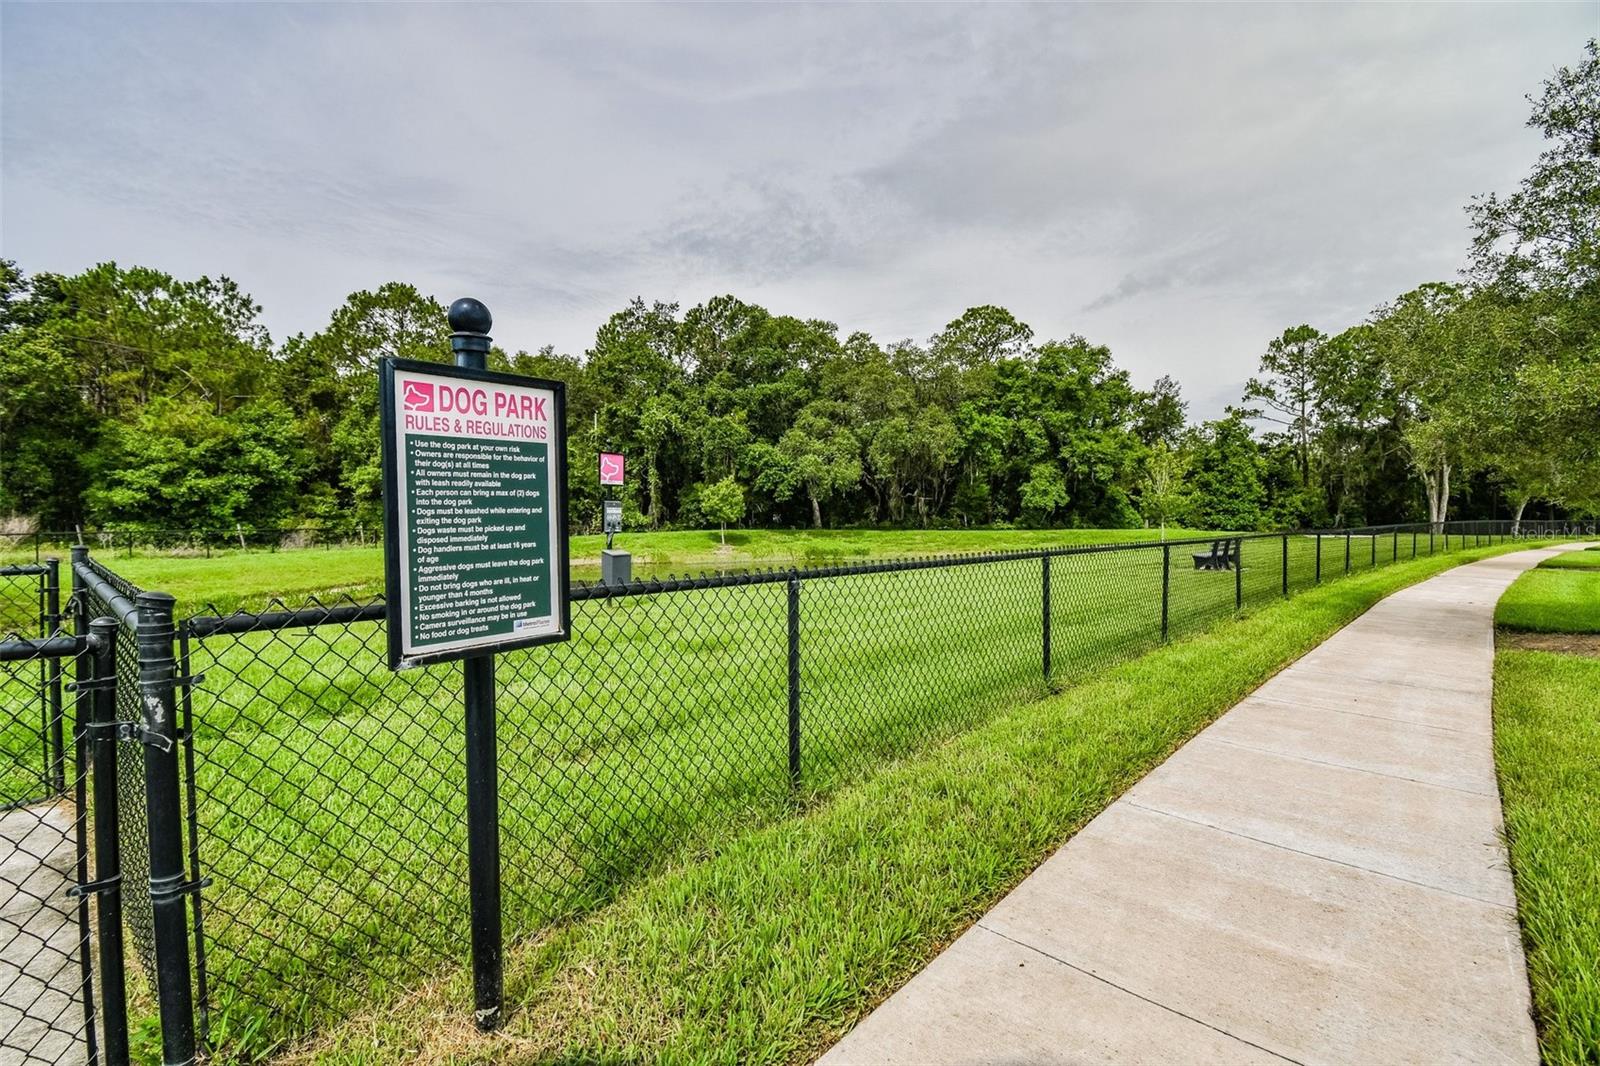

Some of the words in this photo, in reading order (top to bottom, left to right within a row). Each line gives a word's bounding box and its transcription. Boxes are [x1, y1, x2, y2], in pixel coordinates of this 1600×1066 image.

[439, 385, 487, 415] DOG
[495, 393, 547, 421] PARK
[406, 415, 449, 432] RULES
[454, 420, 462, 432] &
[467, 420, 546, 439] REGULATIONS
[442, 442, 455, 450] dog
[457, 443, 471, 451] park
[455, 452, 492, 461] responsible
[432, 460, 454, 469] dog(s)
[473, 489, 489, 497] bring
[443, 498, 456, 506] dog
[417, 508, 435, 516] Dogs
[507, 507, 530, 515] entering
[416, 517, 440, 526] exiting
[453, 517, 466, 525] dog
[417, 527, 435, 535] Dogs
[417, 536, 448, 545] disposed
[450, 535, 488, 543] immediately
[418, 546, 432, 555] Dog
[426, 556, 439, 564] age
[418, 564, 456, 574] Aggressive
[458, 563, 474, 571] dogs
[418, 573, 458, 583] immediately
[443, 582, 460, 591] bring
[462, 580, 478, 589] dogs
[418, 594, 447, 603] younger
[470, 588, 493, 596] months
[419, 601, 454, 611] Excessive
[455, 598, 479, 608] barking
[499, 594, 521, 602] allowed
[431, 610, 460, 620] smoking
[477, 605, 498, 613] around
[510, 602, 522, 611] dog
[523, 601, 536, 609] park
[420, 620, 446, 630] Camera
[448, 616, 486, 626] surveillance
[432, 630, 447, 638] food
[457, 627, 469, 636] dog
[471, 624, 488, 632] treats
